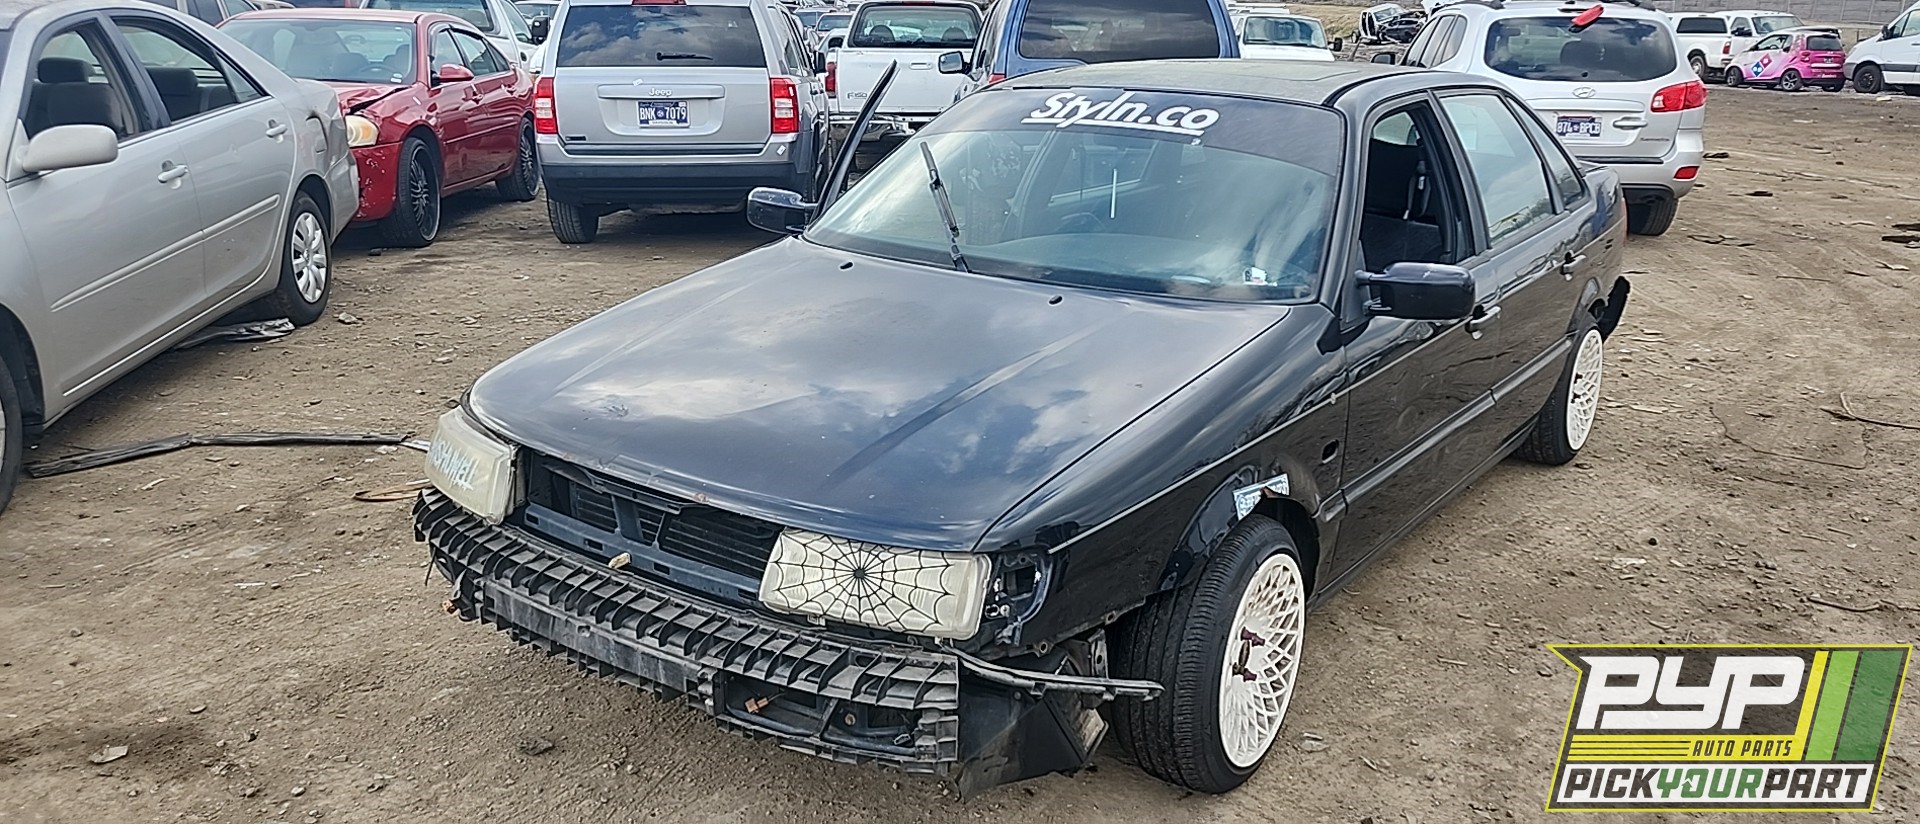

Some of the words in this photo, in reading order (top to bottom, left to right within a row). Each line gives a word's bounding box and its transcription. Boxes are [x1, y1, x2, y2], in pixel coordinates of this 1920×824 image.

[648, 88, 672, 97] Jeep
[640, 107, 656, 120] BNK
[664, 107, 686, 120] 7079
[1030, 91, 1220, 130] Styln.co
